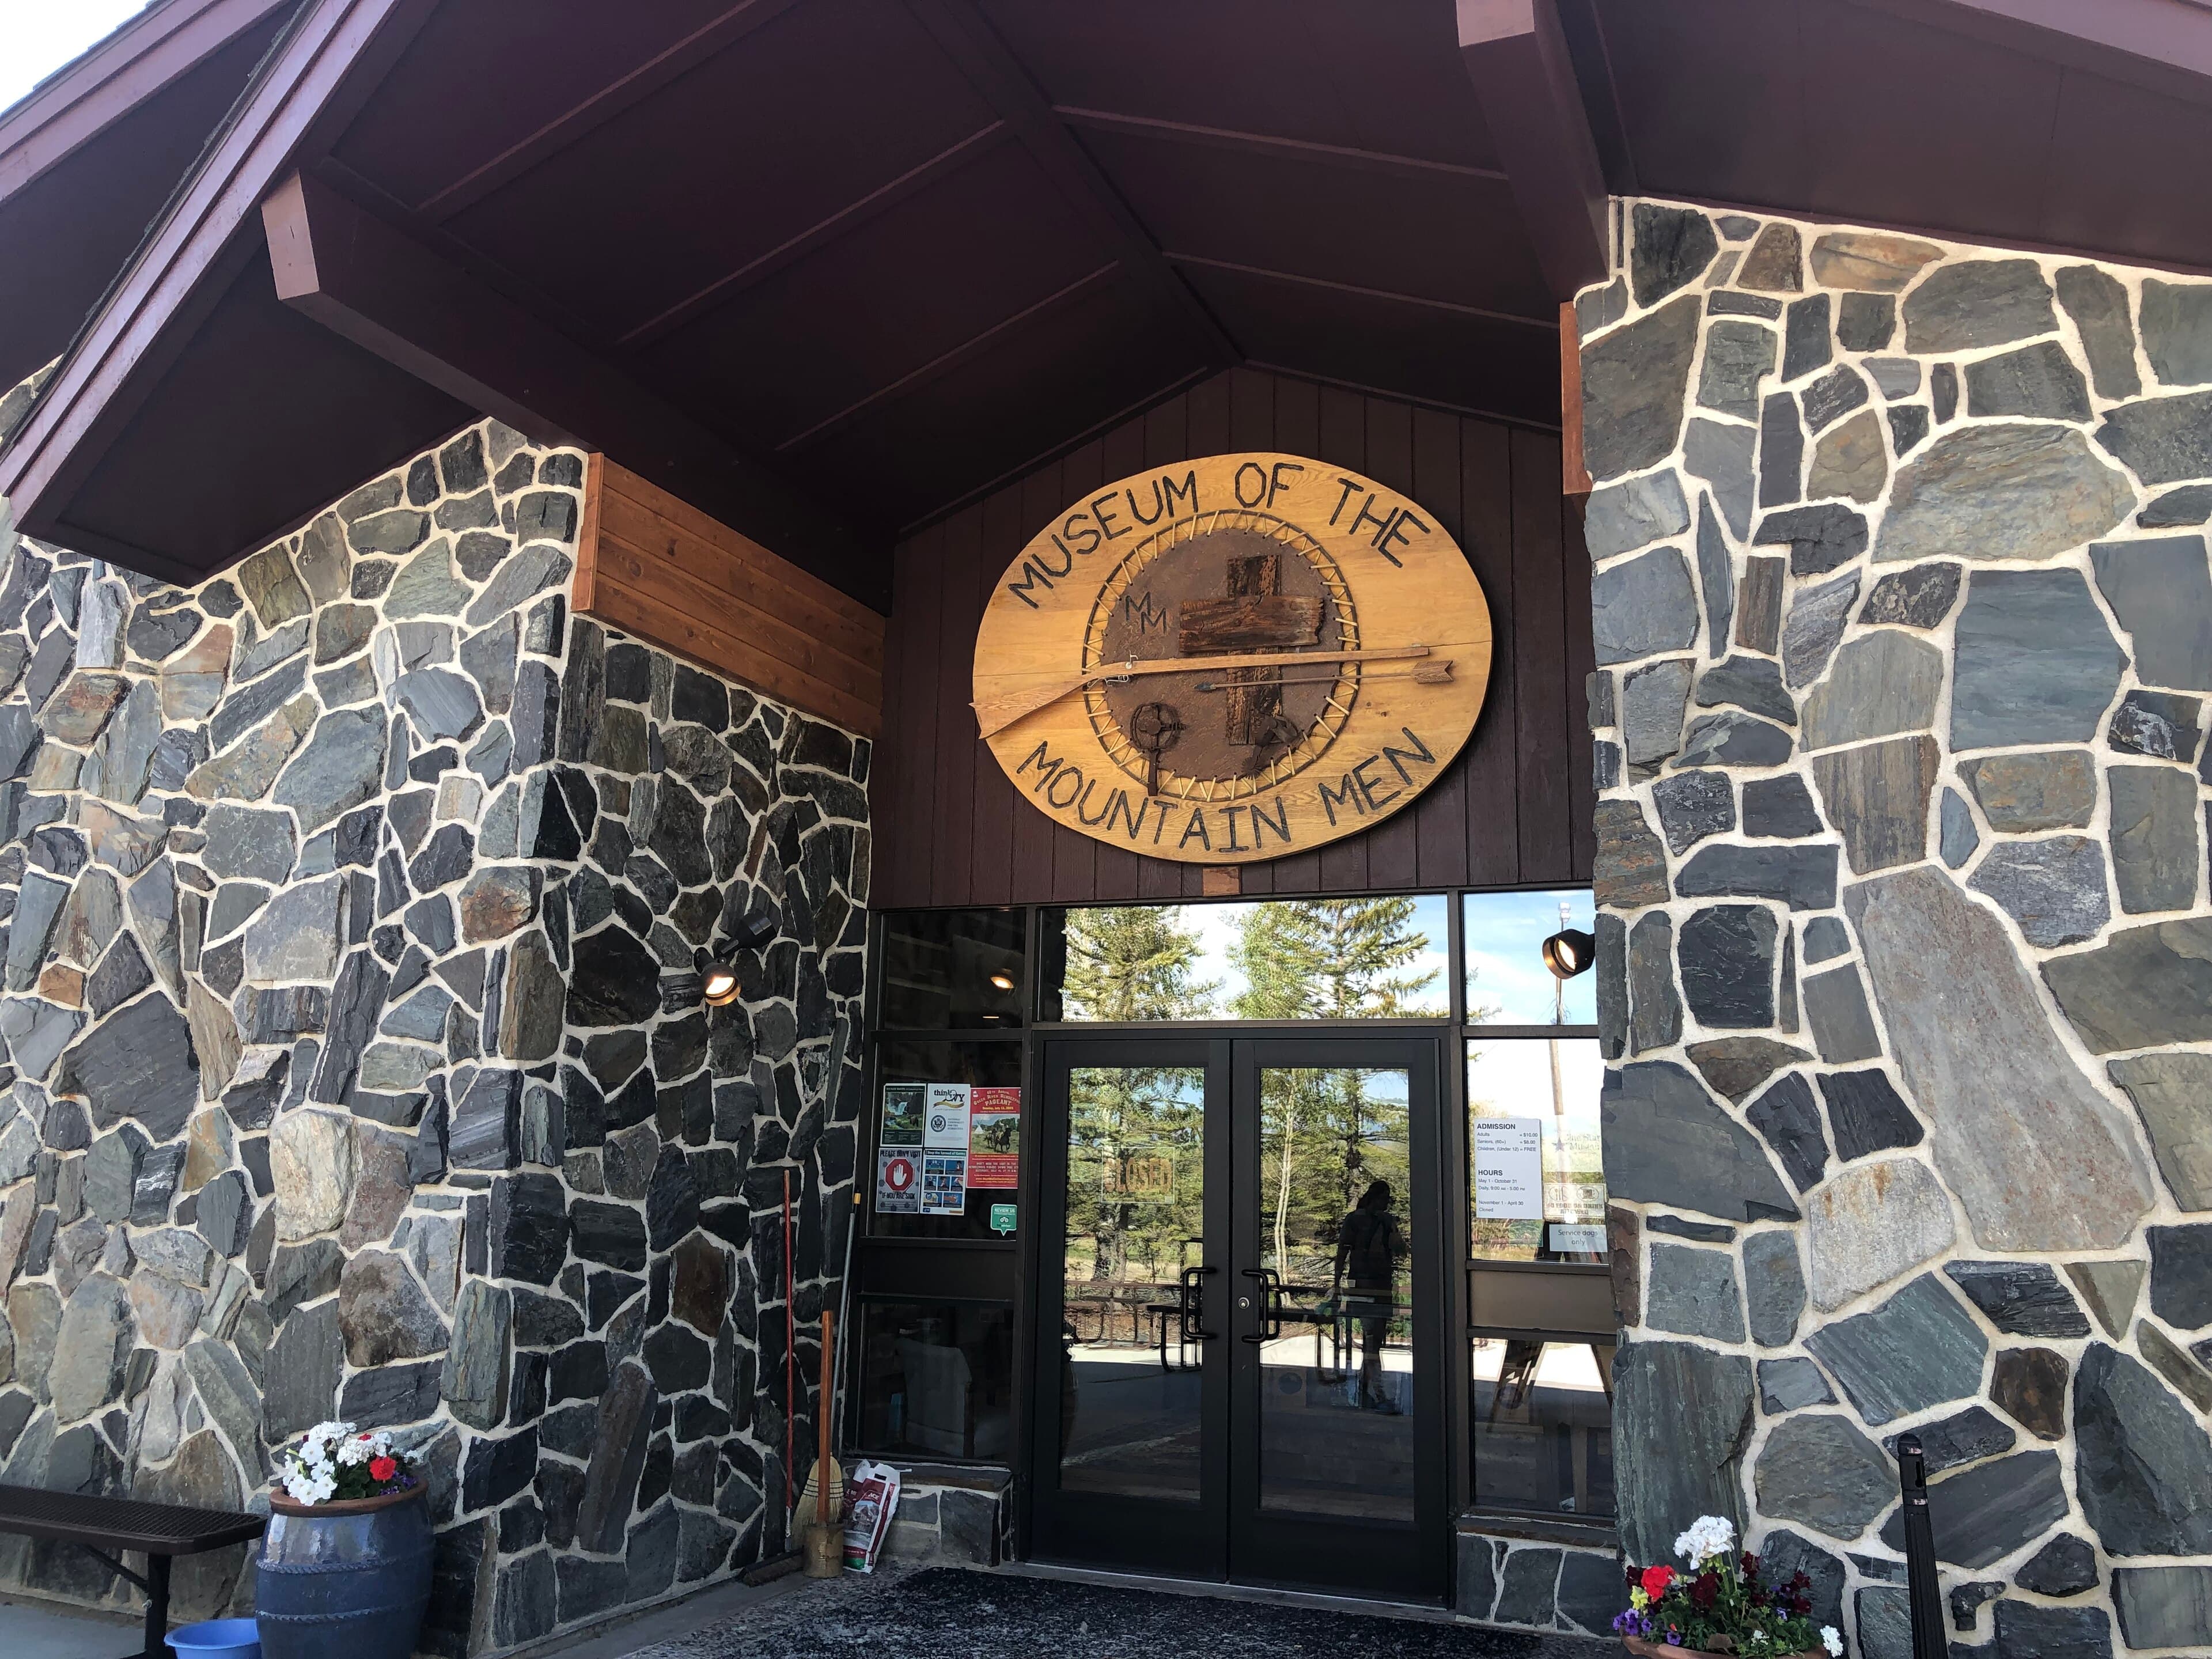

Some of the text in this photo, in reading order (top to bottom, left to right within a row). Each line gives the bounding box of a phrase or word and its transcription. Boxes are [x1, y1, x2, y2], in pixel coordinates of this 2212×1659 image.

[1007, 462, 1431, 609] MUSEUM OF THE
[1016, 727, 1436, 853] MOUNTAIN MEN
[1103, 1157, 1173, 1192] CLOSED
[868, 1492, 880, 1500] ACE
